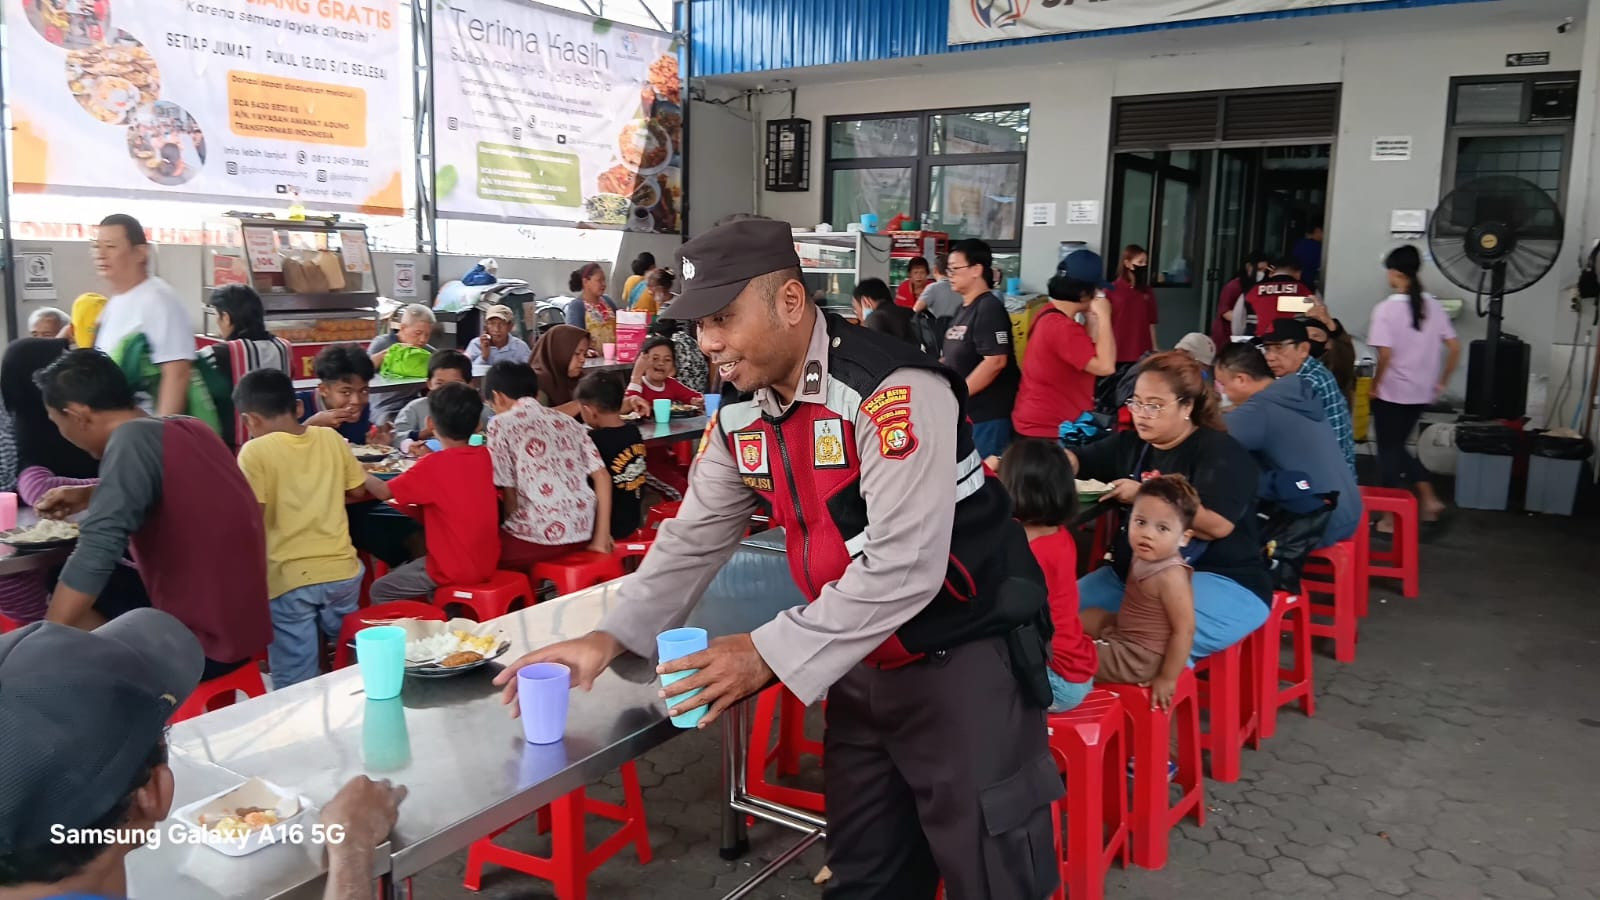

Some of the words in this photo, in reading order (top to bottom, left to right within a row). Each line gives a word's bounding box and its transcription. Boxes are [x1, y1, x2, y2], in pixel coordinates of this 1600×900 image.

[186, 0, 236, 20] Karena
[239, 12, 282, 28] semua
[284, 19, 319, 35] layak
[317, 0, 392, 30] GRATIS
[450, 6, 540, 55] Terima
[547, 31, 609, 69] Kasih
[166, 32, 208, 51] SETIAP
[212, 40, 252, 59] JUMAT
[266, 49, 298, 67] PUKUL
[302, 55, 327, 71] 12.00
[352, 63, 388, 80] SELESAI
[1258, 283, 1298, 295] POLISI
[742, 476, 773, 491] POLISI
